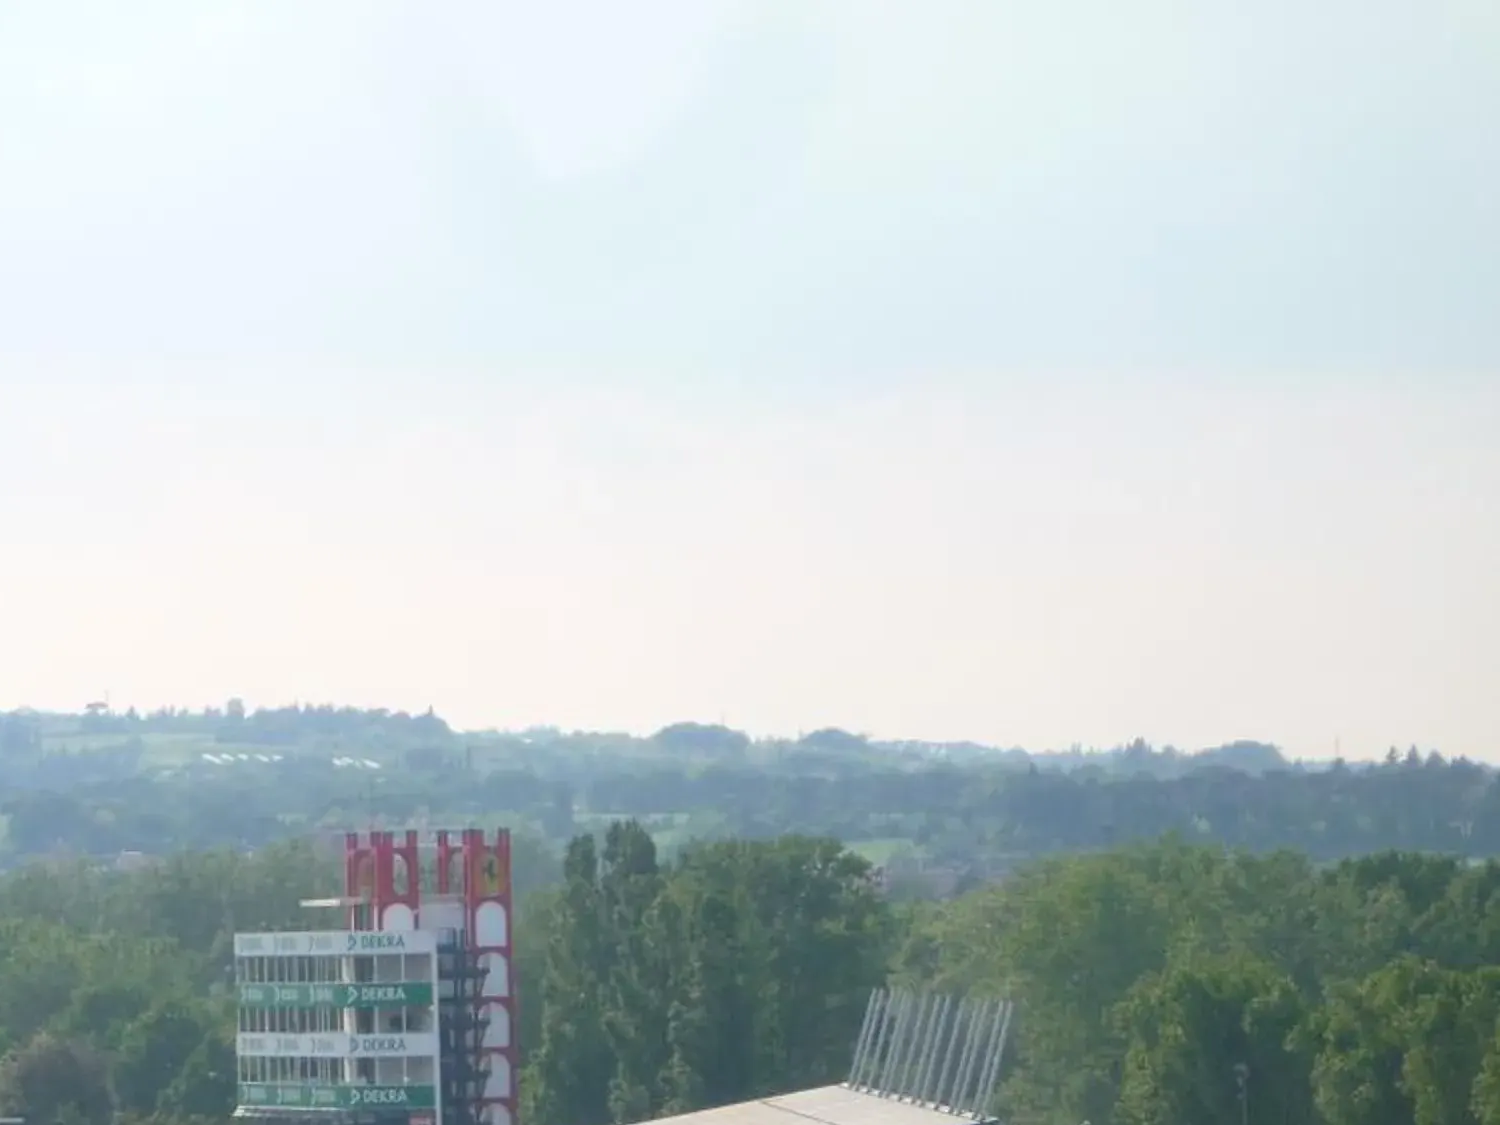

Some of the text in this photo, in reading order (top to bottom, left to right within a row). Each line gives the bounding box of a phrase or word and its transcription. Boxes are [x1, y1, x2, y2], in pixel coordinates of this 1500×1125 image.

[361, 935, 405, 949] DEKRA
[361, 986, 406, 1001] DEKRA
[362, 1038, 407, 1052] DEKRA
[363, 1088, 408, 1104] DEKRA
